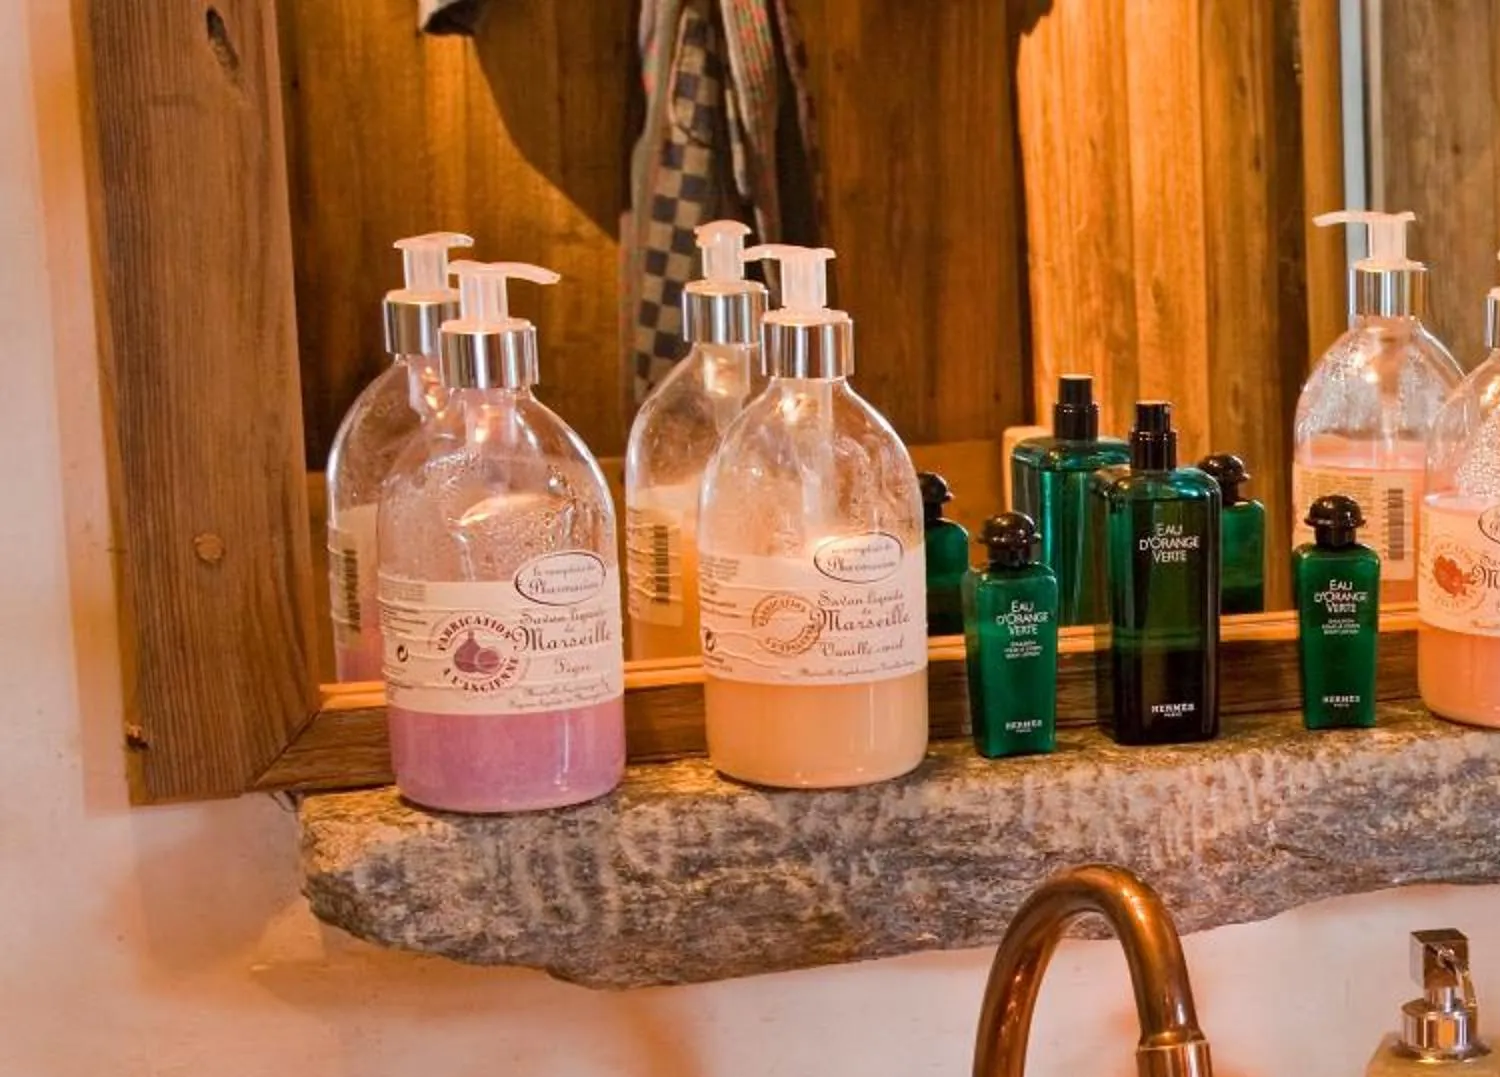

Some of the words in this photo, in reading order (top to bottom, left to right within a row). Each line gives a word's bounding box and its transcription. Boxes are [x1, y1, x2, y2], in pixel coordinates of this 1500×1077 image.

[1155, 523, 1184, 537] EAU
[1139, 535, 1200, 551] D'ORANGE
[1151, 549, 1188, 564] VERTE
[1329, 579, 1353, 590] EAU
[1313, 591, 1369, 603] D'ORANGE
[1011, 599, 1035, 613] EAU
[1326, 602, 1357, 613] VERTE
[816, 602, 911, 632] Marseille
[995, 611, 1049, 626] D'ORANGE
[510, 619, 613, 652] Marseille
[1007, 623, 1039, 636] VERTE
